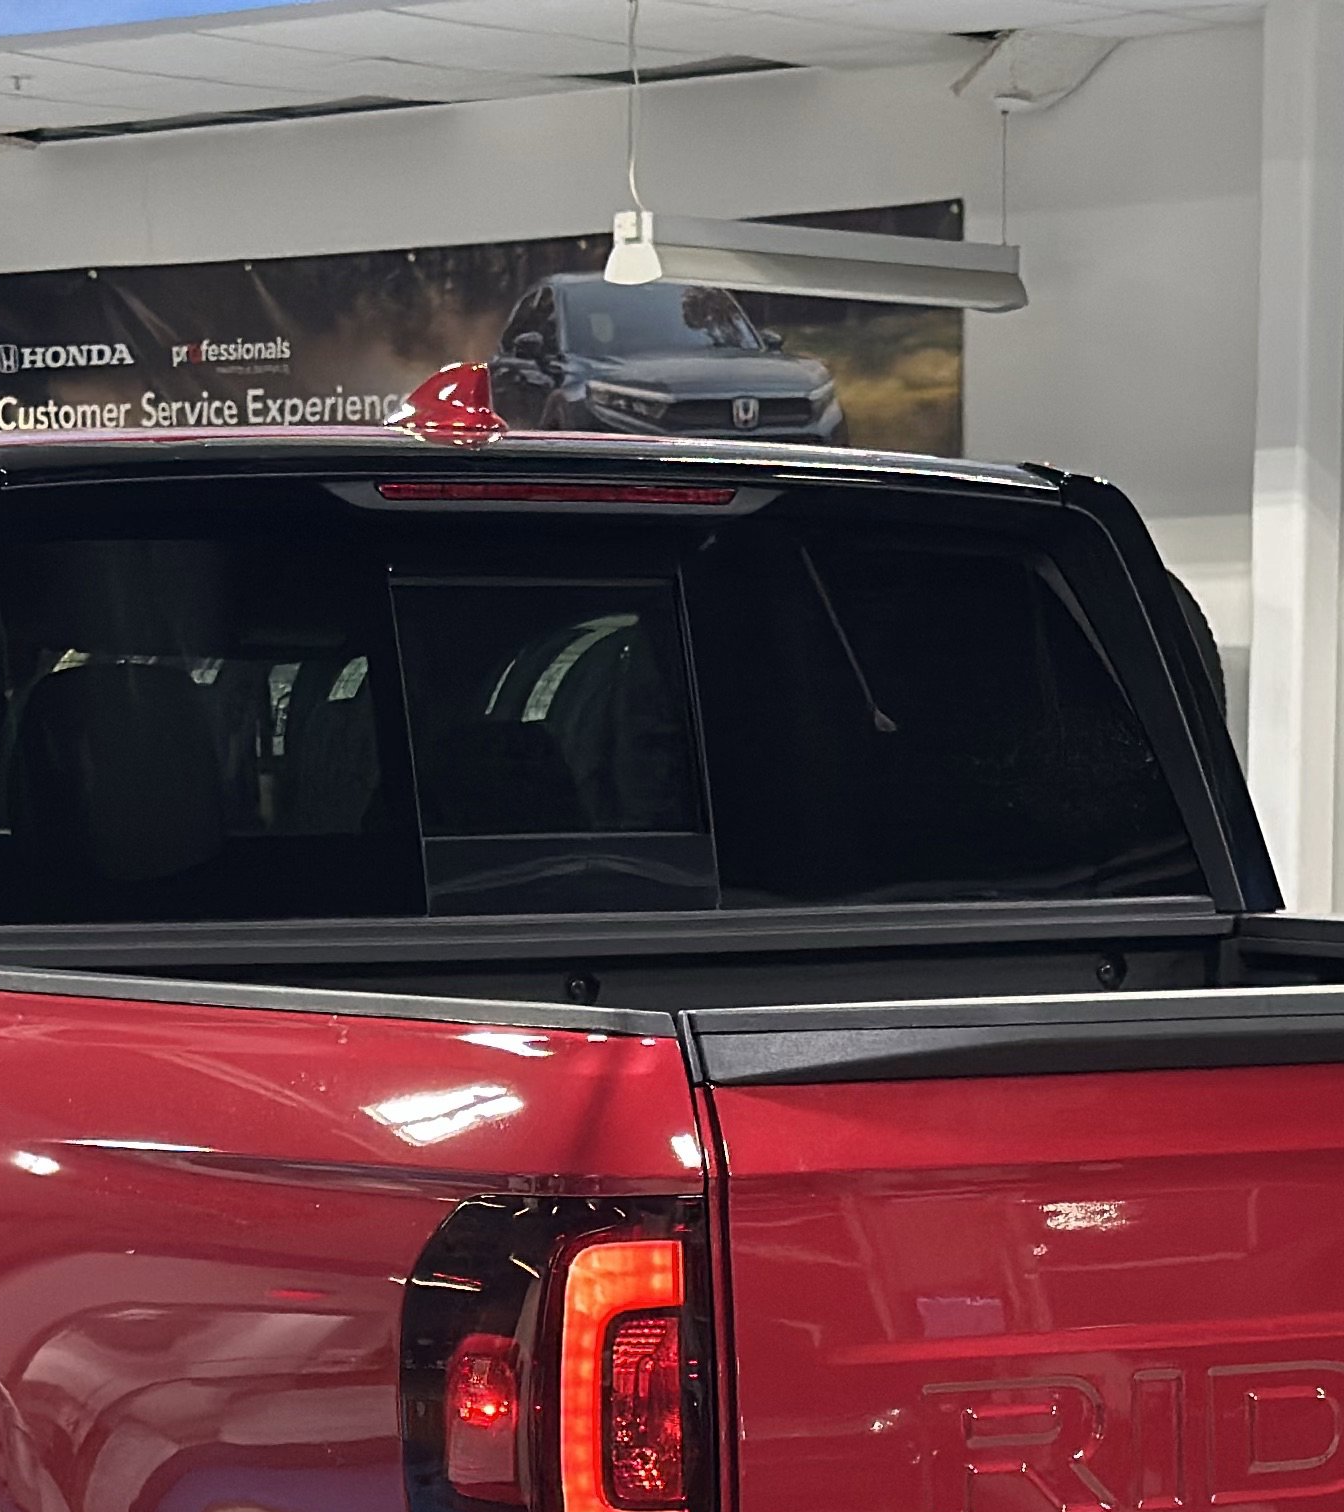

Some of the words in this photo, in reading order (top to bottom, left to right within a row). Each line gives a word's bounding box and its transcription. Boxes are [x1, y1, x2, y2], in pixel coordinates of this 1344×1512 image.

[21, 343, 135, 369] HONDA
[172, 337, 291, 367] professionals
[140, 391, 238, 428] Service
[246, 384, 411, 425] Experienc
